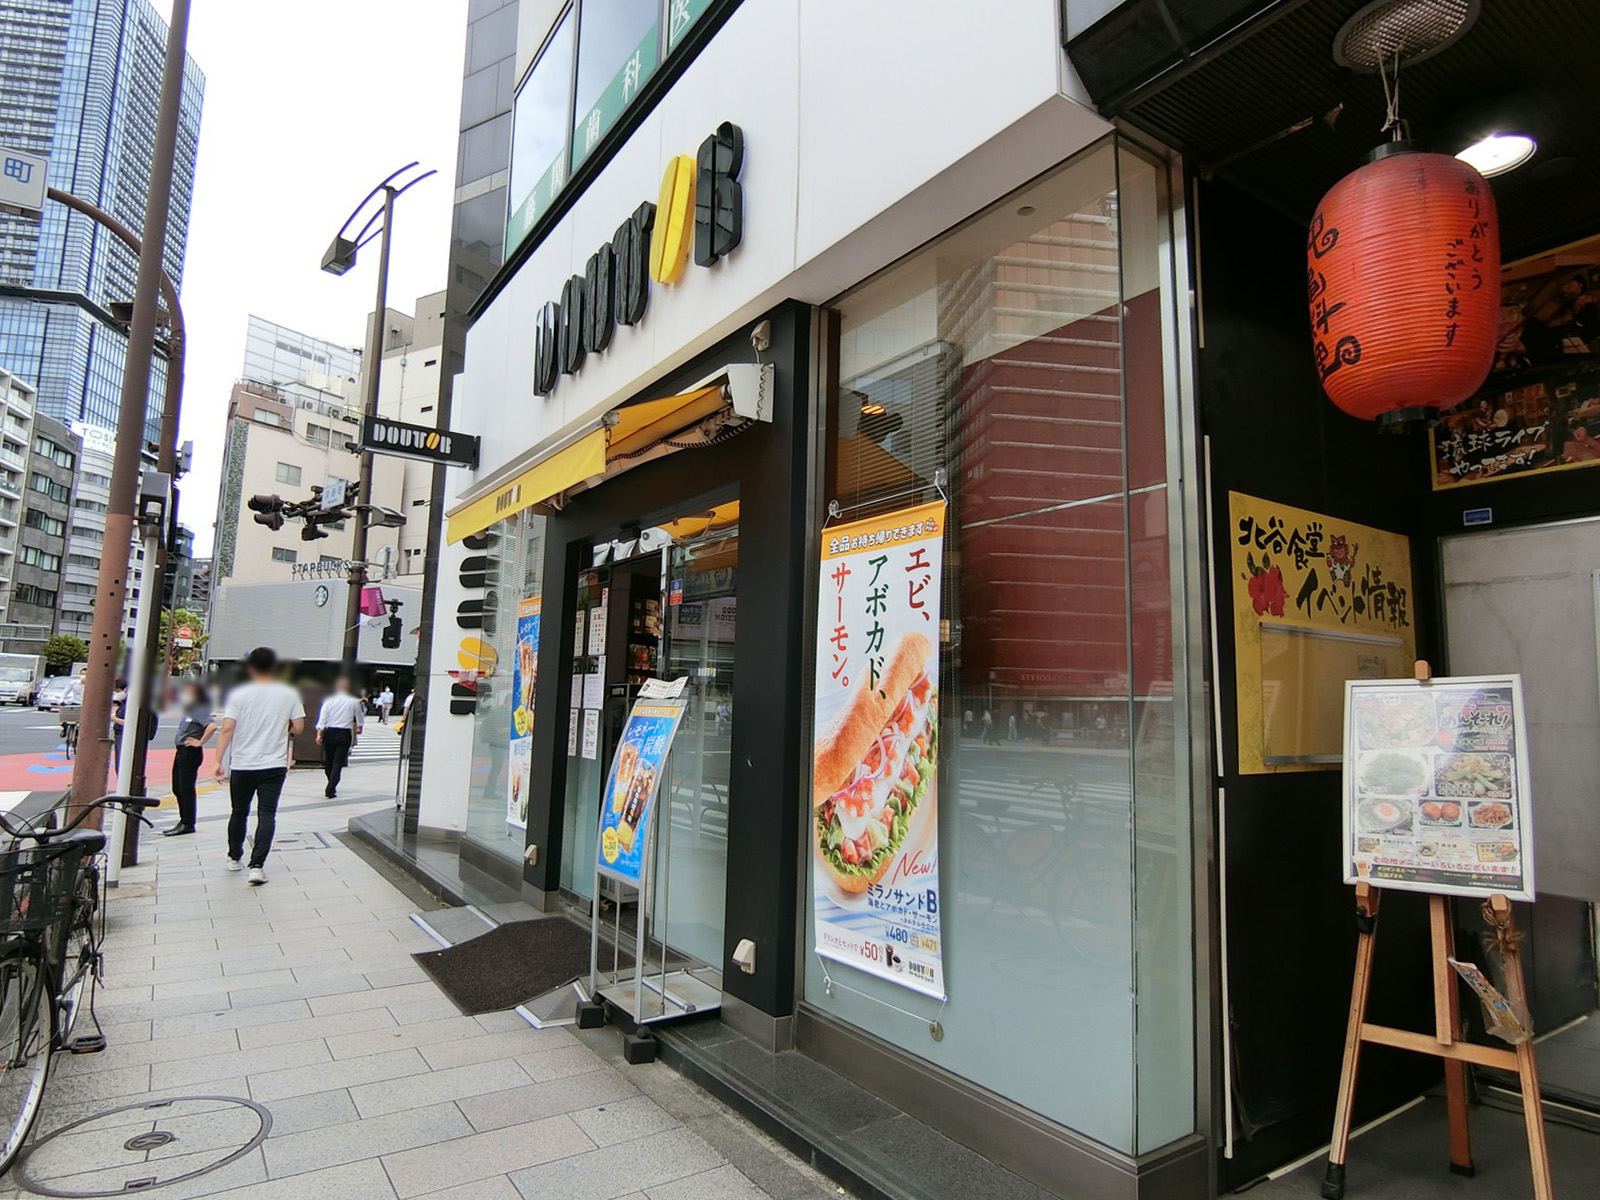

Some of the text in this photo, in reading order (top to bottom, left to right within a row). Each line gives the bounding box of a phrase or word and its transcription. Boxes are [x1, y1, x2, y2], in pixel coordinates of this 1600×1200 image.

[4, 157, 35, 184] 町
[533, 120, 746, 397] DOUTOR
[1465, 181, 1489, 290] ありがとう
[1445, 238, 1464, 347] ございます
[373, 423, 452, 454] DOUTOR
[1440, 421, 1550, 460] 琉球ライブ
[829, 521, 924, 555] 全品お持ち帰りできます
[1238, 516, 1325, 571] 北谷食堂
[291, 559, 350, 574] STARBUCKS
[904, 548, 931, 621] エビ、
[1296, 563, 1410, 630] イベント情報
[829, 561, 852, 687] サーモン。
[865, 554, 889, 700] アボカド、
[892, 850, 937, 885] New!
[867, 881, 938, 914] ミラノサンドB
[885, 925, 909, 944] ¥480
